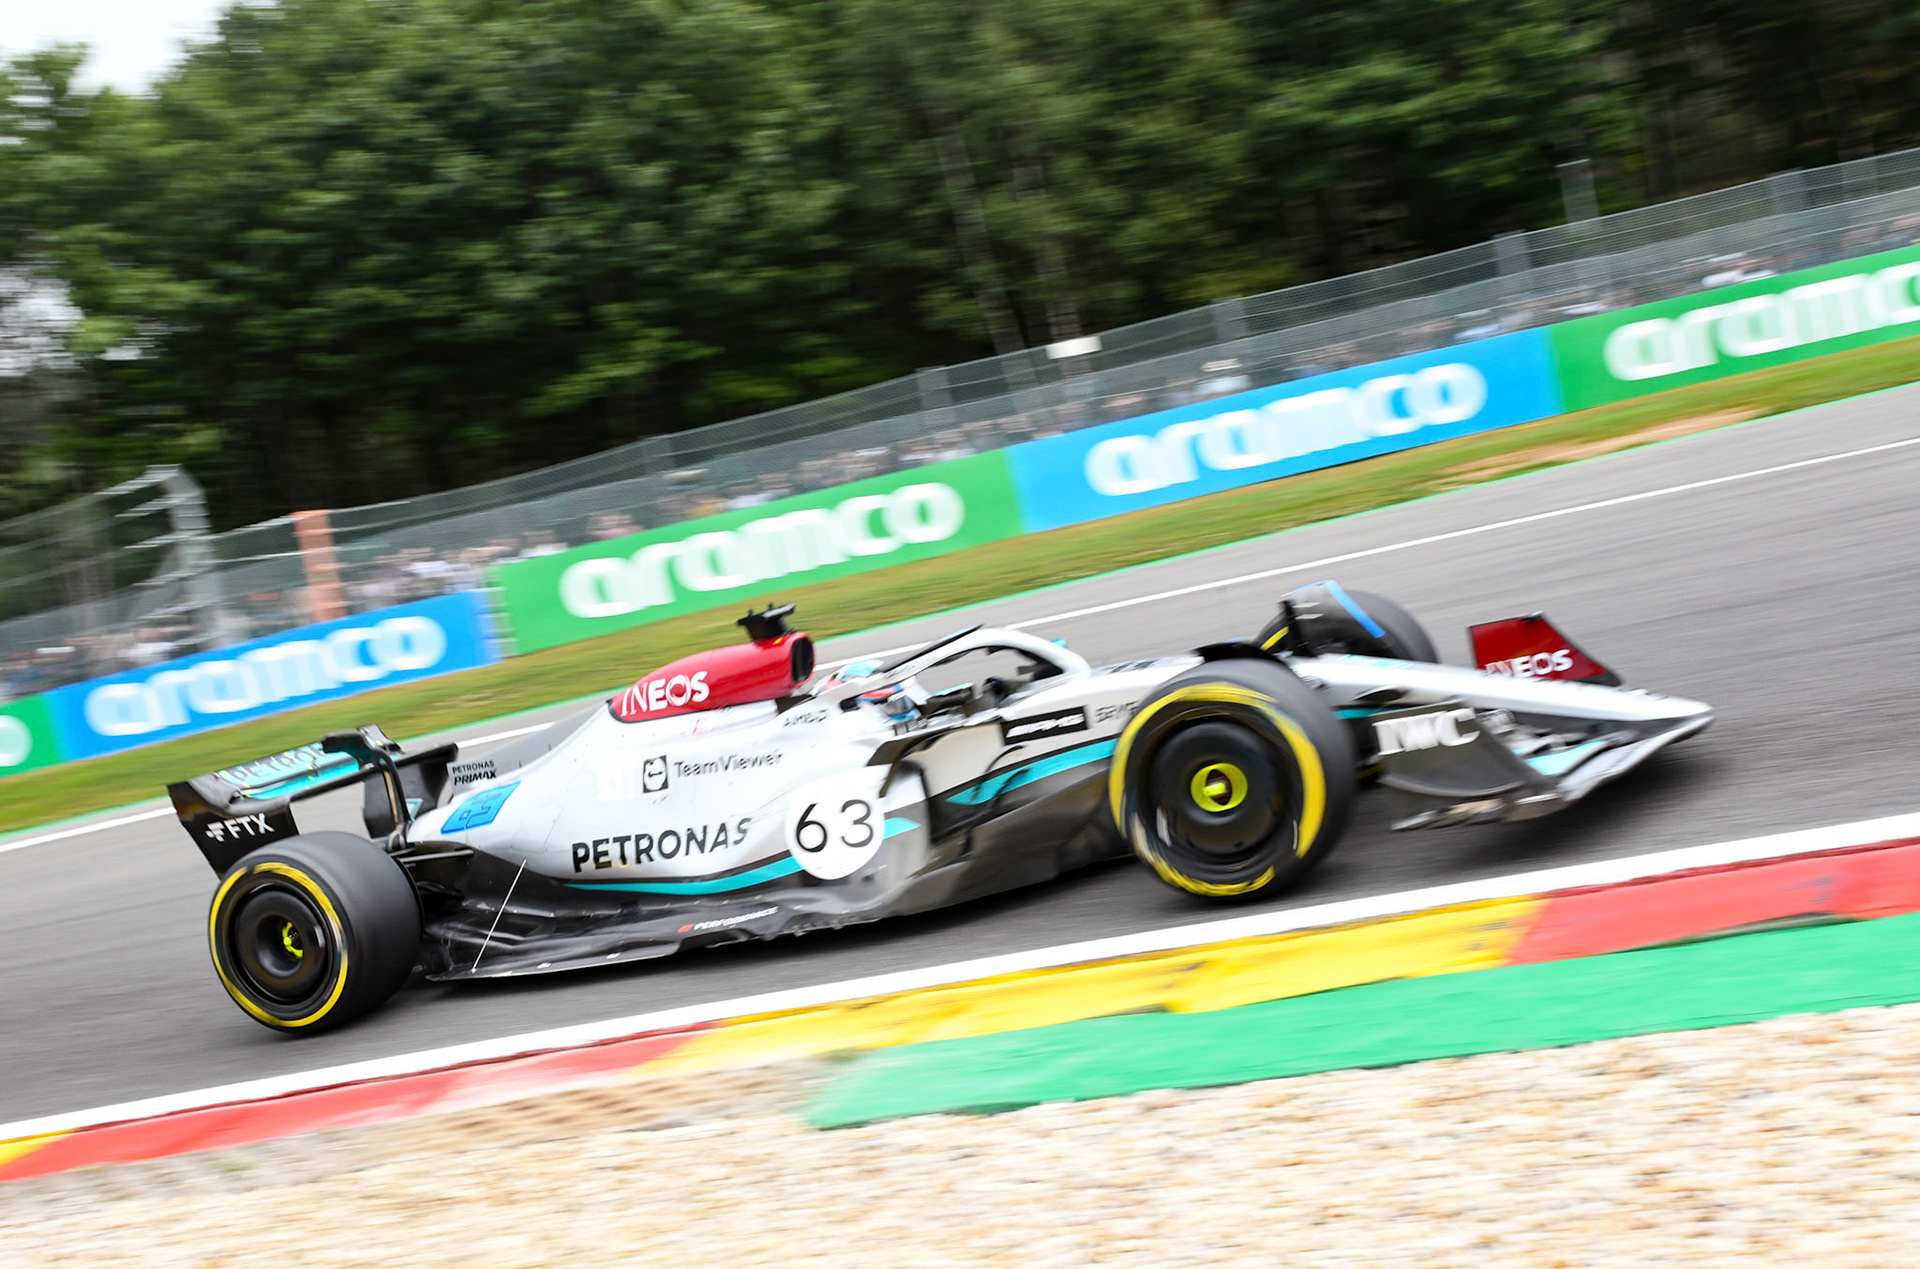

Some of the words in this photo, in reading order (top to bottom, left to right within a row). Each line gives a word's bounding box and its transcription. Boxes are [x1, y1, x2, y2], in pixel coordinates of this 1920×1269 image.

[1085, 363, 1487, 495] aramco
[559, 482, 965, 618] aramco
[84, 616, 447, 736] aramco
[620, 670, 710, 717] INEOS
[452, 760, 495, 774] PETRONAS
[454, 769, 497, 786] PRIMAX
[674, 751, 783, 777] TeamViewer
[222, 813, 275, 839] FTX
[572, 817, 753, 873] PETRONAS
[796, 799, 873, 853] 63
